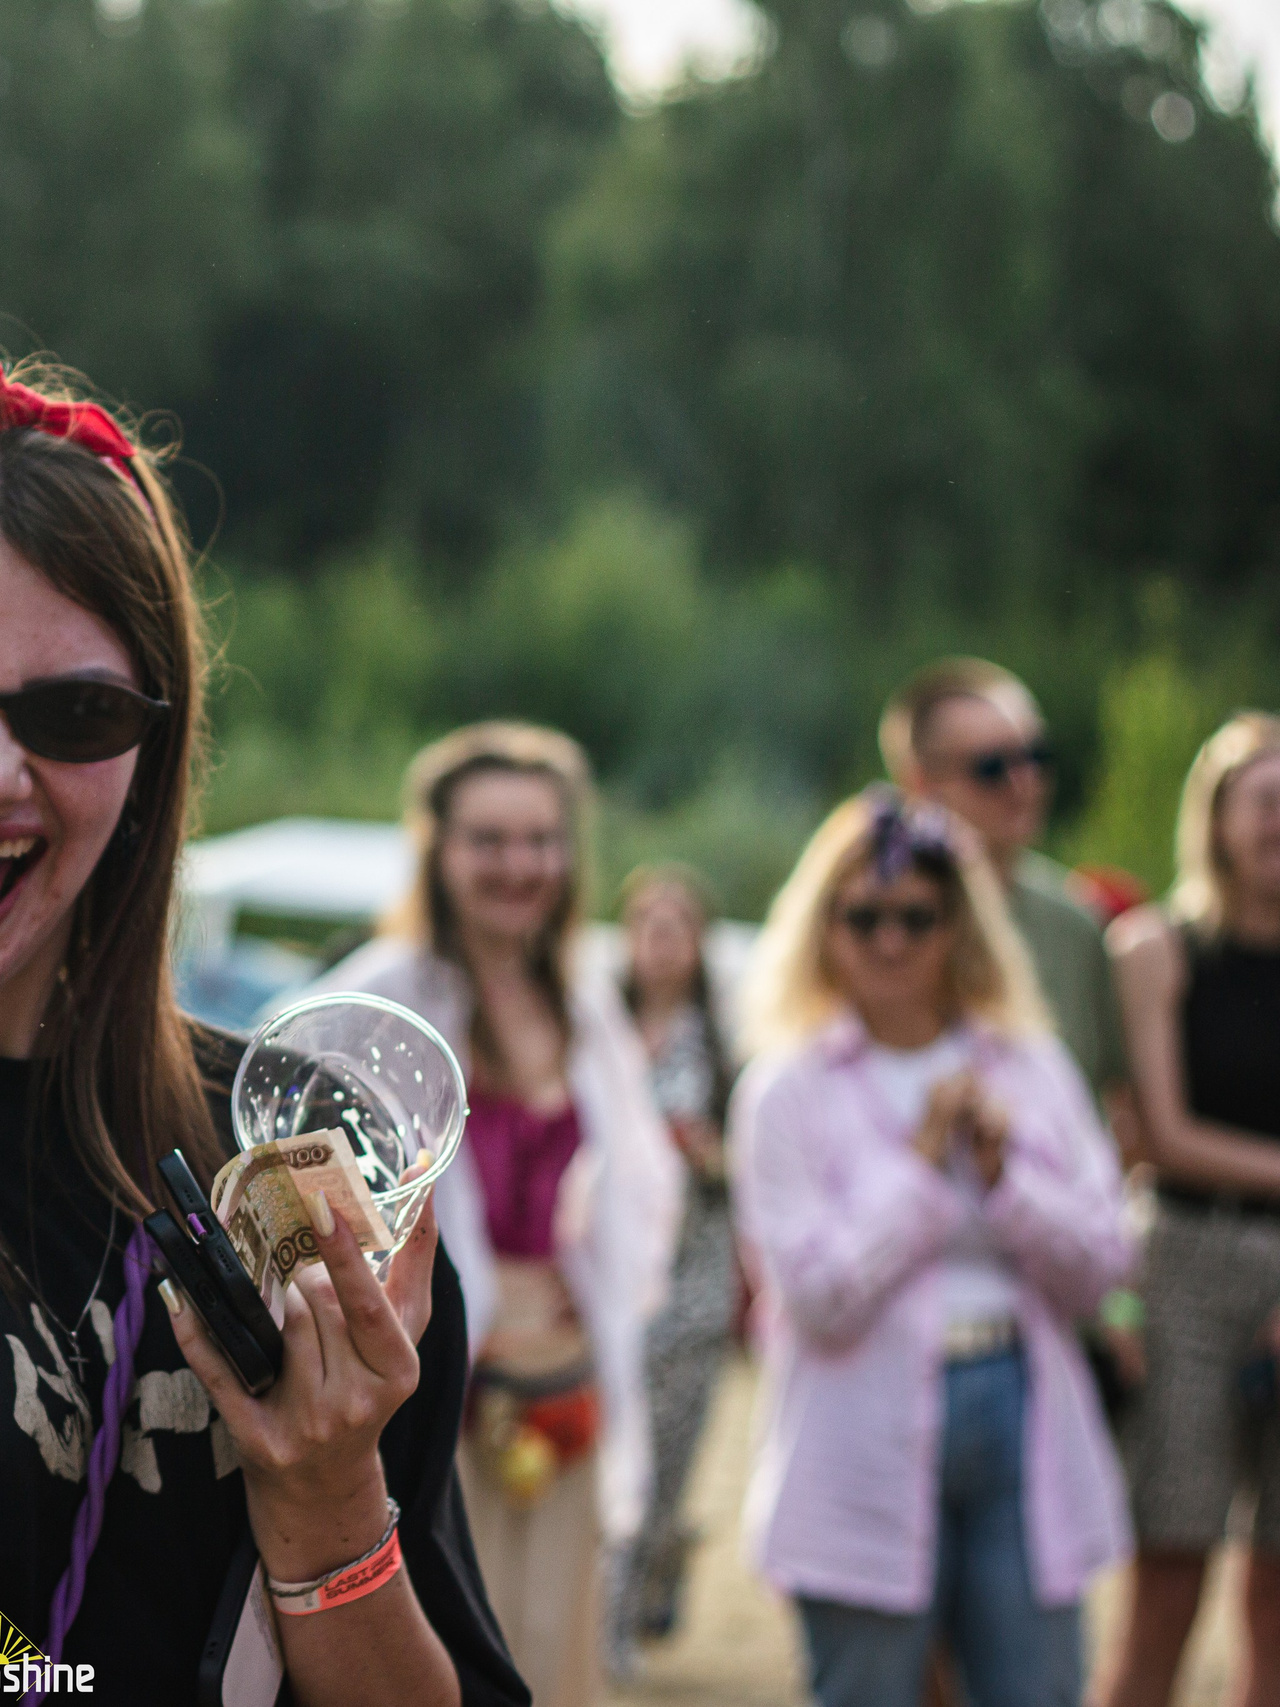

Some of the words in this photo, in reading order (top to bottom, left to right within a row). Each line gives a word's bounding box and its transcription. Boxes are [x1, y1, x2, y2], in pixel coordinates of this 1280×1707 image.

[287, 1146, 324, 1167] 100
[271, 1226, 320, 1287] 100
[324, 1567, 369, 1592] LAST
